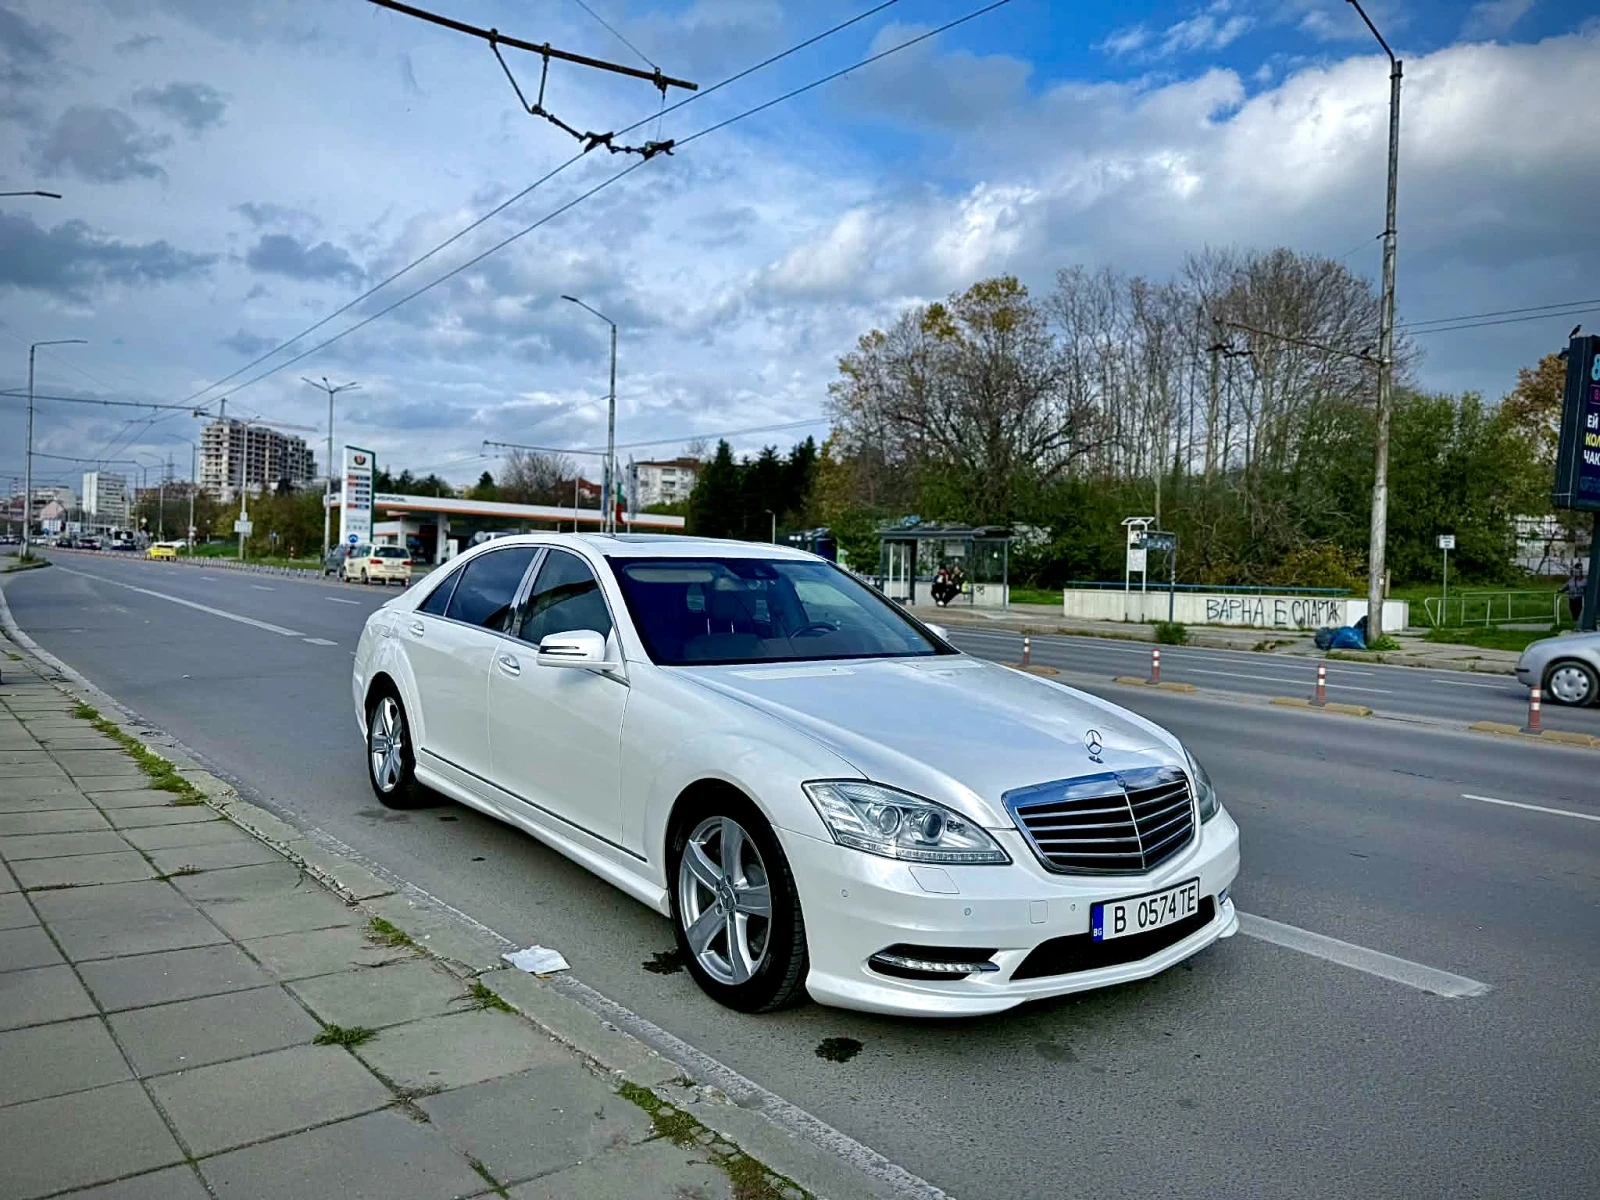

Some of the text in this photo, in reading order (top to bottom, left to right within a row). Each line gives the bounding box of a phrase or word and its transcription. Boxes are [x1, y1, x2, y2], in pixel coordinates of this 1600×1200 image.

[1206, 598, 1264, 626] ВАРНА
[1292, 599, 1341, 627] СПАРТАК
[1114, 885, 1196, 934] B 0574 TE
[1093, 928, 1103, 937] BG
